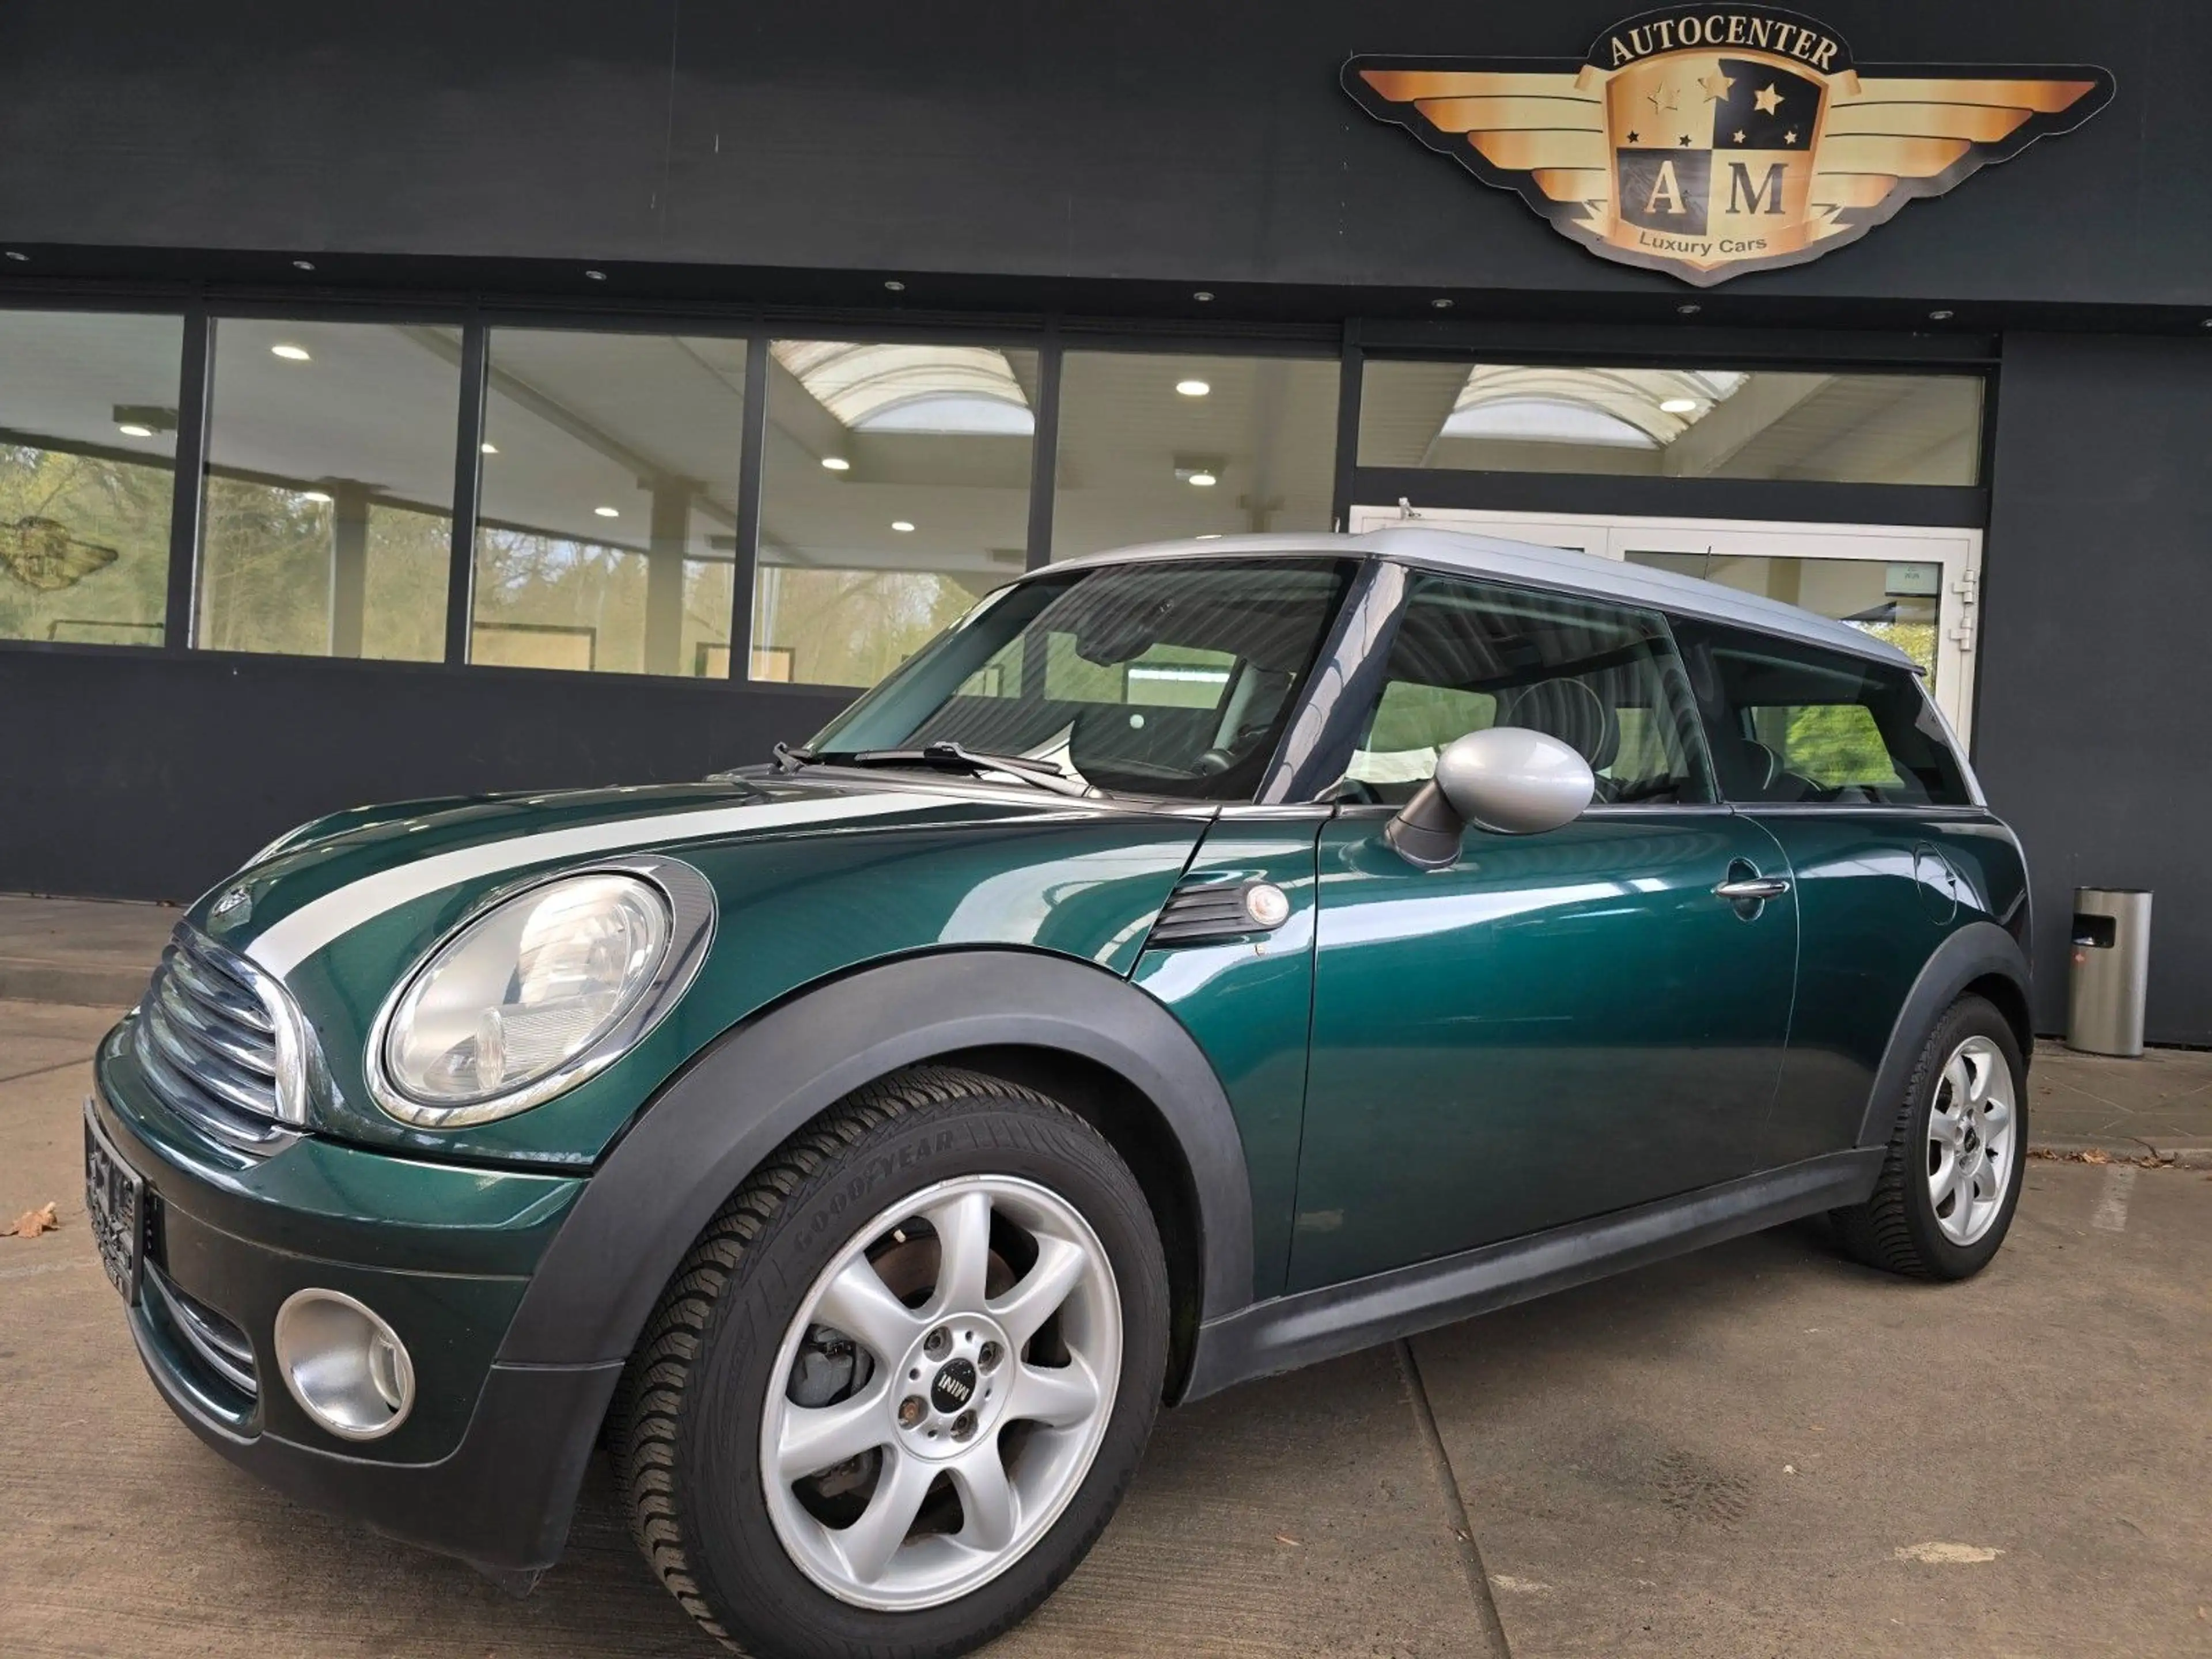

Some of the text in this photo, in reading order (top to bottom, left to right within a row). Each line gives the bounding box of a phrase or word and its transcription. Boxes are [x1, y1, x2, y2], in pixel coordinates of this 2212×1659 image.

[1611, 15, 1838, 70] AUTOCENTER
[1644, 160, 1789, 214] A M
[1639, 232, 1767, 256] Luxury Cars
[794, 1130, 953, 1252] GOODYEAR
[938, 1373, 970, 1401] MINI
